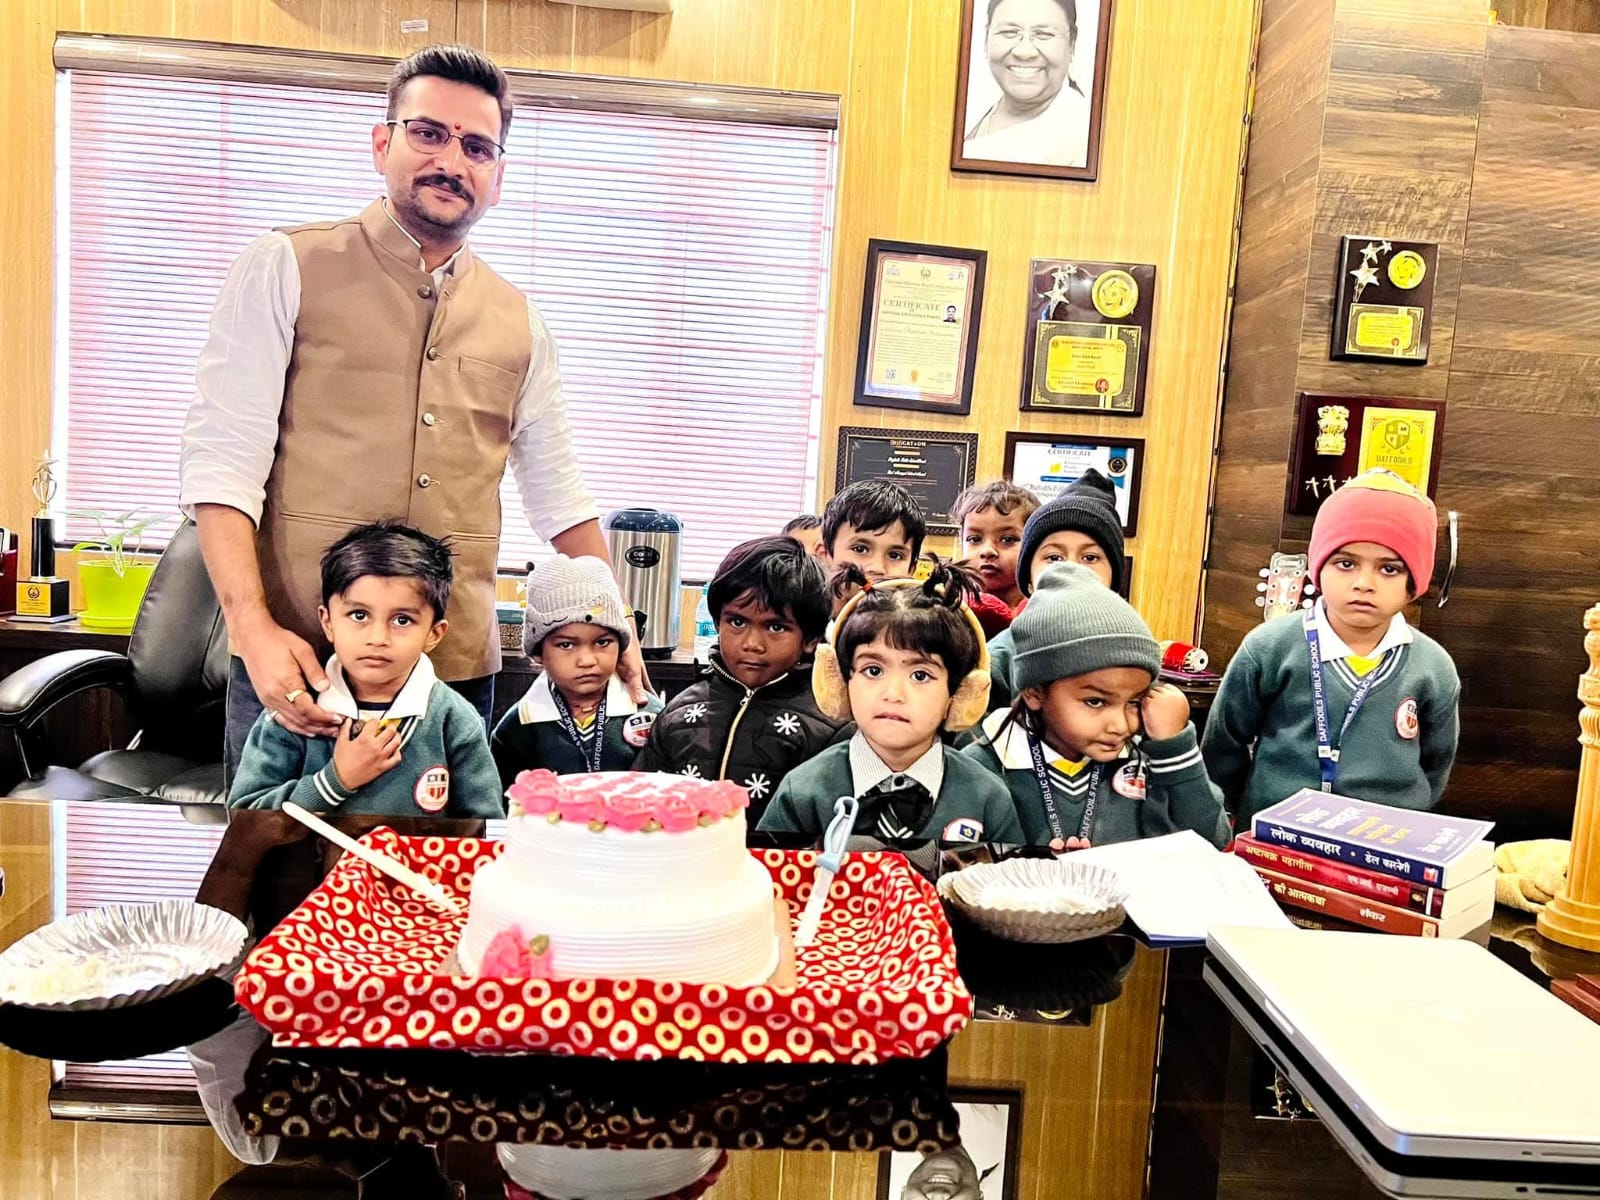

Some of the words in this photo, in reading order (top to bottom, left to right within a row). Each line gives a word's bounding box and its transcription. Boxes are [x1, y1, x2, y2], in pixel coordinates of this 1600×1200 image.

[1376, 455, 1413, 465] DAFFODILS
[1311, 639, 1320, 670] SCHOOL
[1314, 670, 1323, 698] PUBLIC
[1351, 680, 1370, 707] PUBLIC
[597, 704, 606, 730] PUBLIC
[1317, 699, 1327, 742] DAFFODILS
[1032, 744, 1047, 778] SCHOOL
[1040, 780, 1055, 812] PUBLIC
[1081, 791, 1097, 839] DAFFODILS
[1090, 767, 1100, 791] PUBL
[1270, 827, 1297, 843] लोक
[1300, 836, 1342, 856] व्यवहार
[1364, 851, 1380, 865] डेल
[1273, 882, 1286, 894] की
